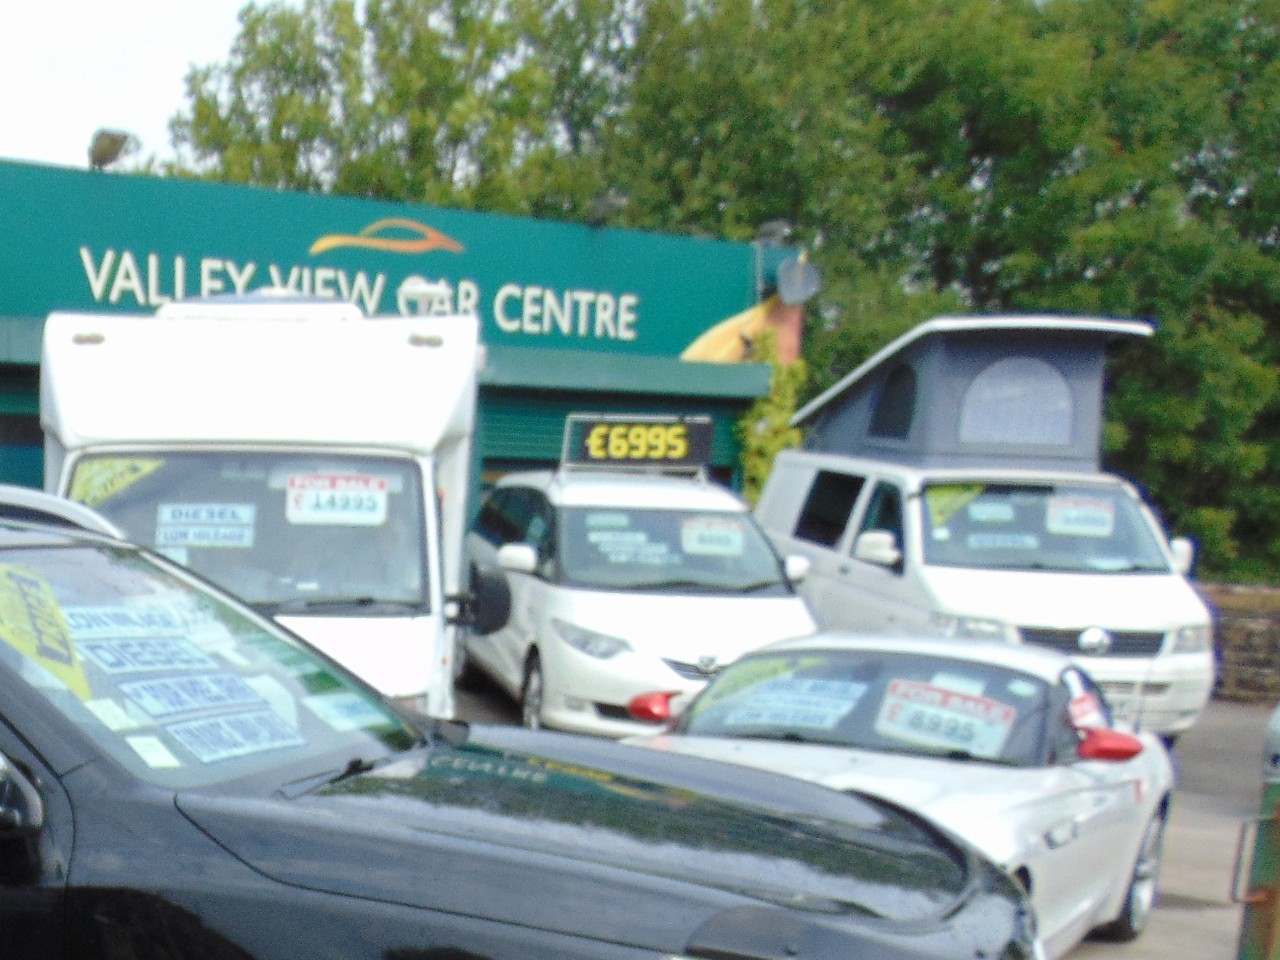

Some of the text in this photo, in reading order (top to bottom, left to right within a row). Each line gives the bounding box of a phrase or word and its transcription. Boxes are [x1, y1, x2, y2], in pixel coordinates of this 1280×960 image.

[494, 284, 639, 342] CENTRE
[171, 507, 243, 521] DIESEL
[84, 641, 211, 669] DIESEL
